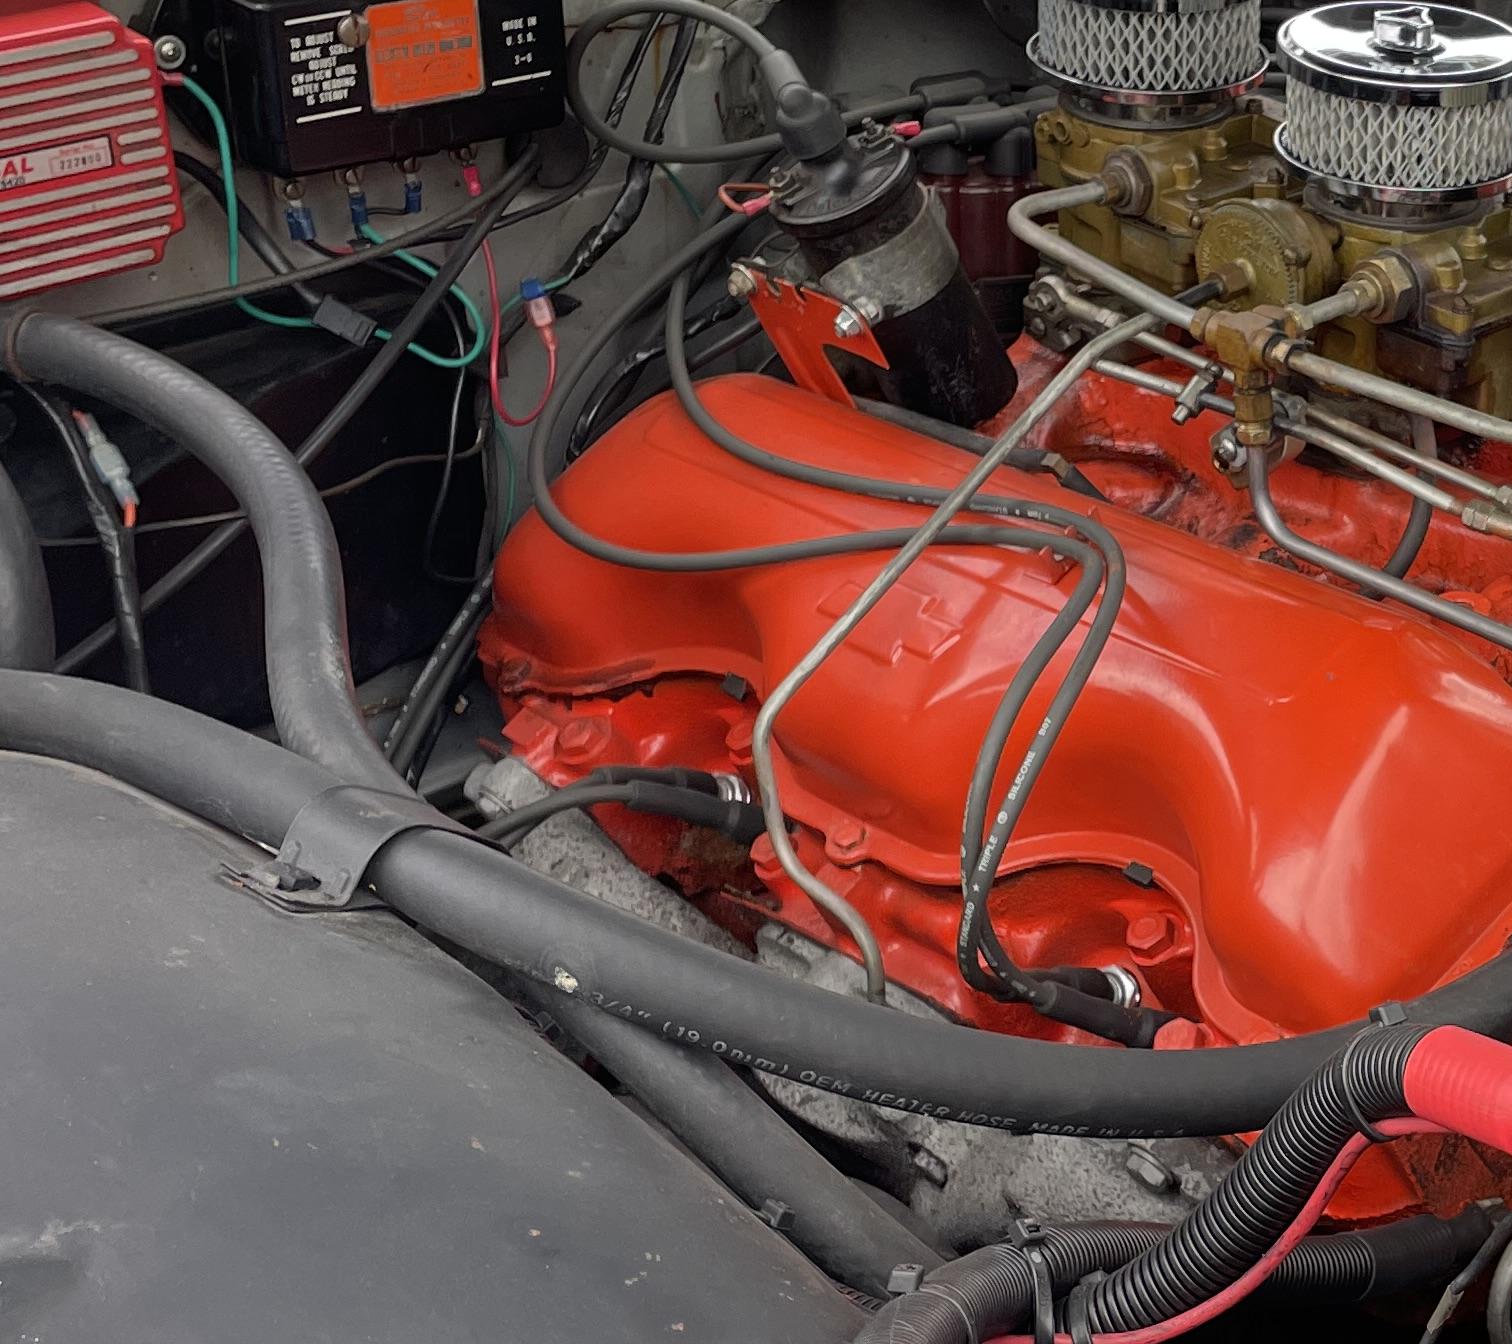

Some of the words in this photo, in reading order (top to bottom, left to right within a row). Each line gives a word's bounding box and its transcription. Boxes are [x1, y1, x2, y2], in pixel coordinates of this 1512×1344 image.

[978, 835, 998, 873] TRIPLE
[800, 1070, 851, 1093] OEM
[861, 1088, 951, 1117] HEATER
[958, 1111, 1017, 1129] HOSE
